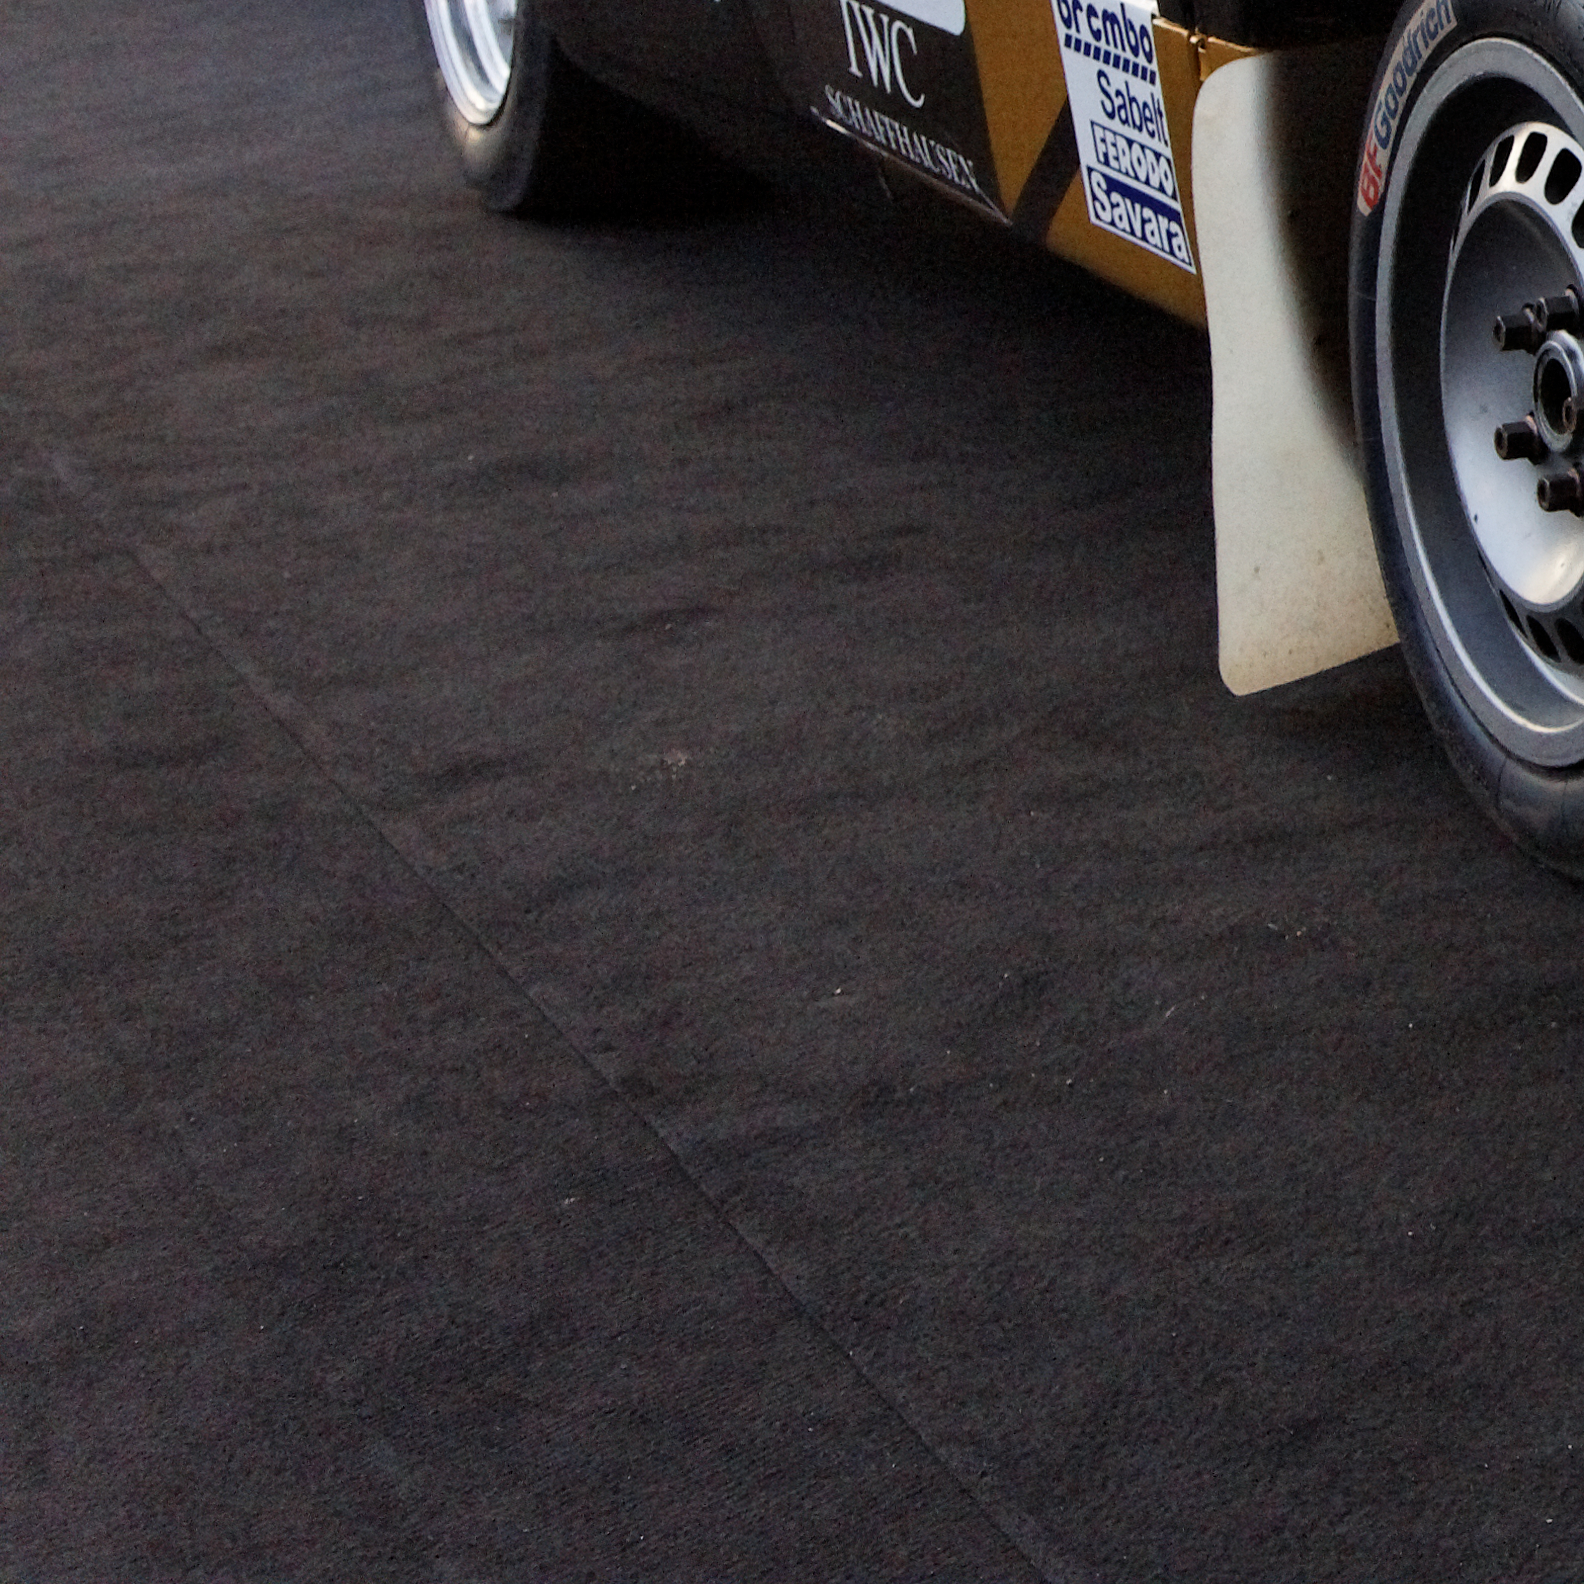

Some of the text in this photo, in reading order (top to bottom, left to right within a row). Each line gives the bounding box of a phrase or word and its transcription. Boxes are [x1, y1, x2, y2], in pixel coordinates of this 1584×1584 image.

[825, 85, 981, 193] SCHAFFHAUSEN
[1096, 69, 1168, 149] Sabelt
[1092, 124, 1175, 197] FERODO
[1090, 170, 1190, 264] Savara
